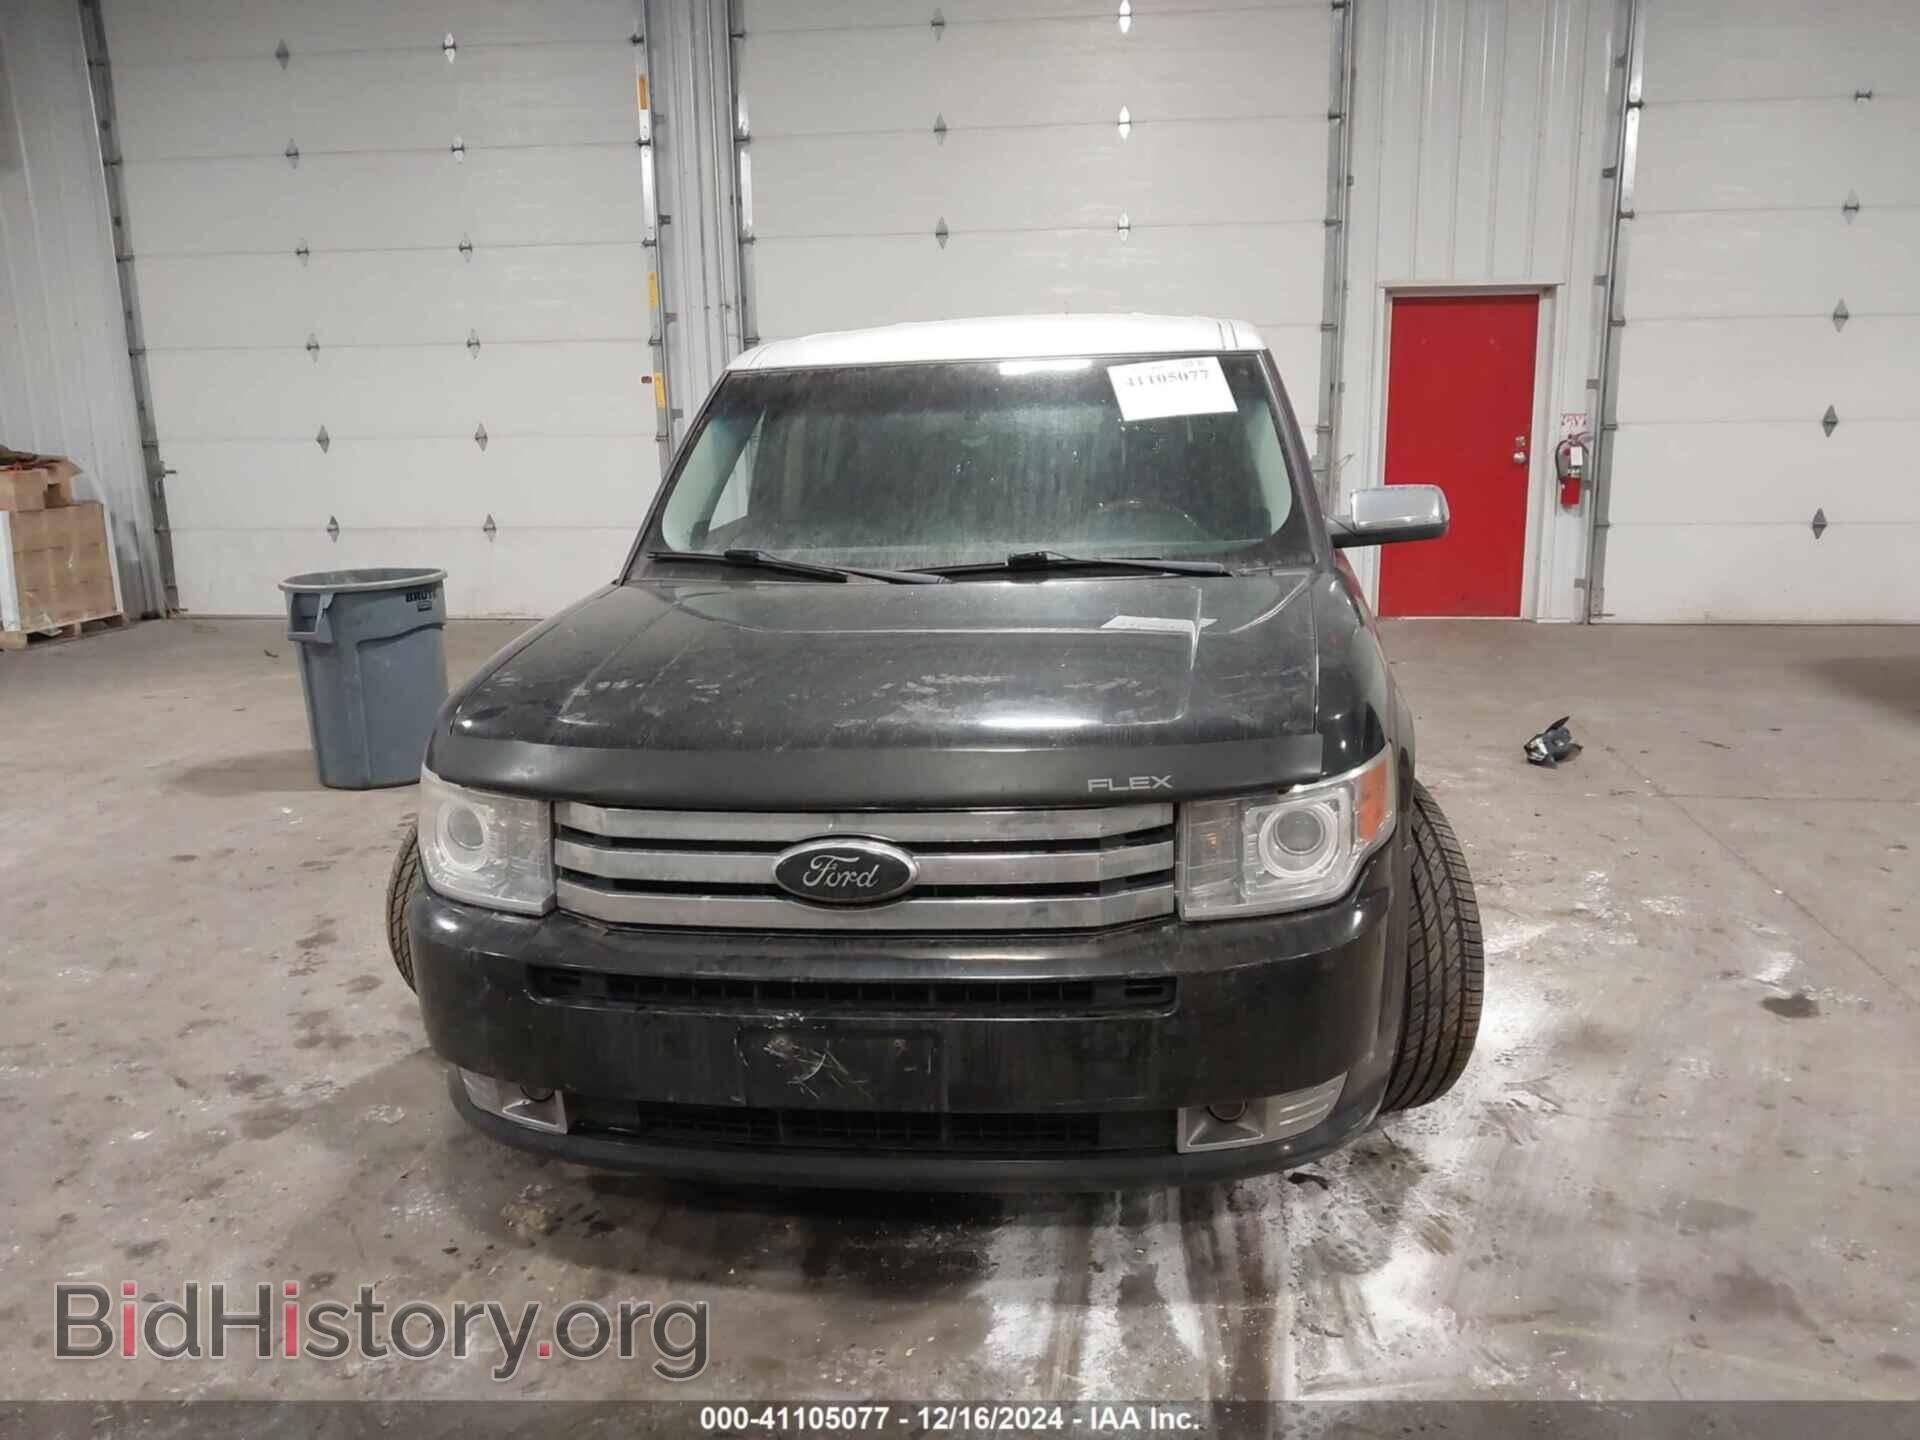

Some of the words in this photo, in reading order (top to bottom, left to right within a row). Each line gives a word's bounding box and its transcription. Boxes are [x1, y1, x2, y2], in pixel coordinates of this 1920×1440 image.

[1126, 368, 1209, 387] 41105077
[1087, 775, 1173, 793] FLEX
[802, 854, 880, 888] Ford
